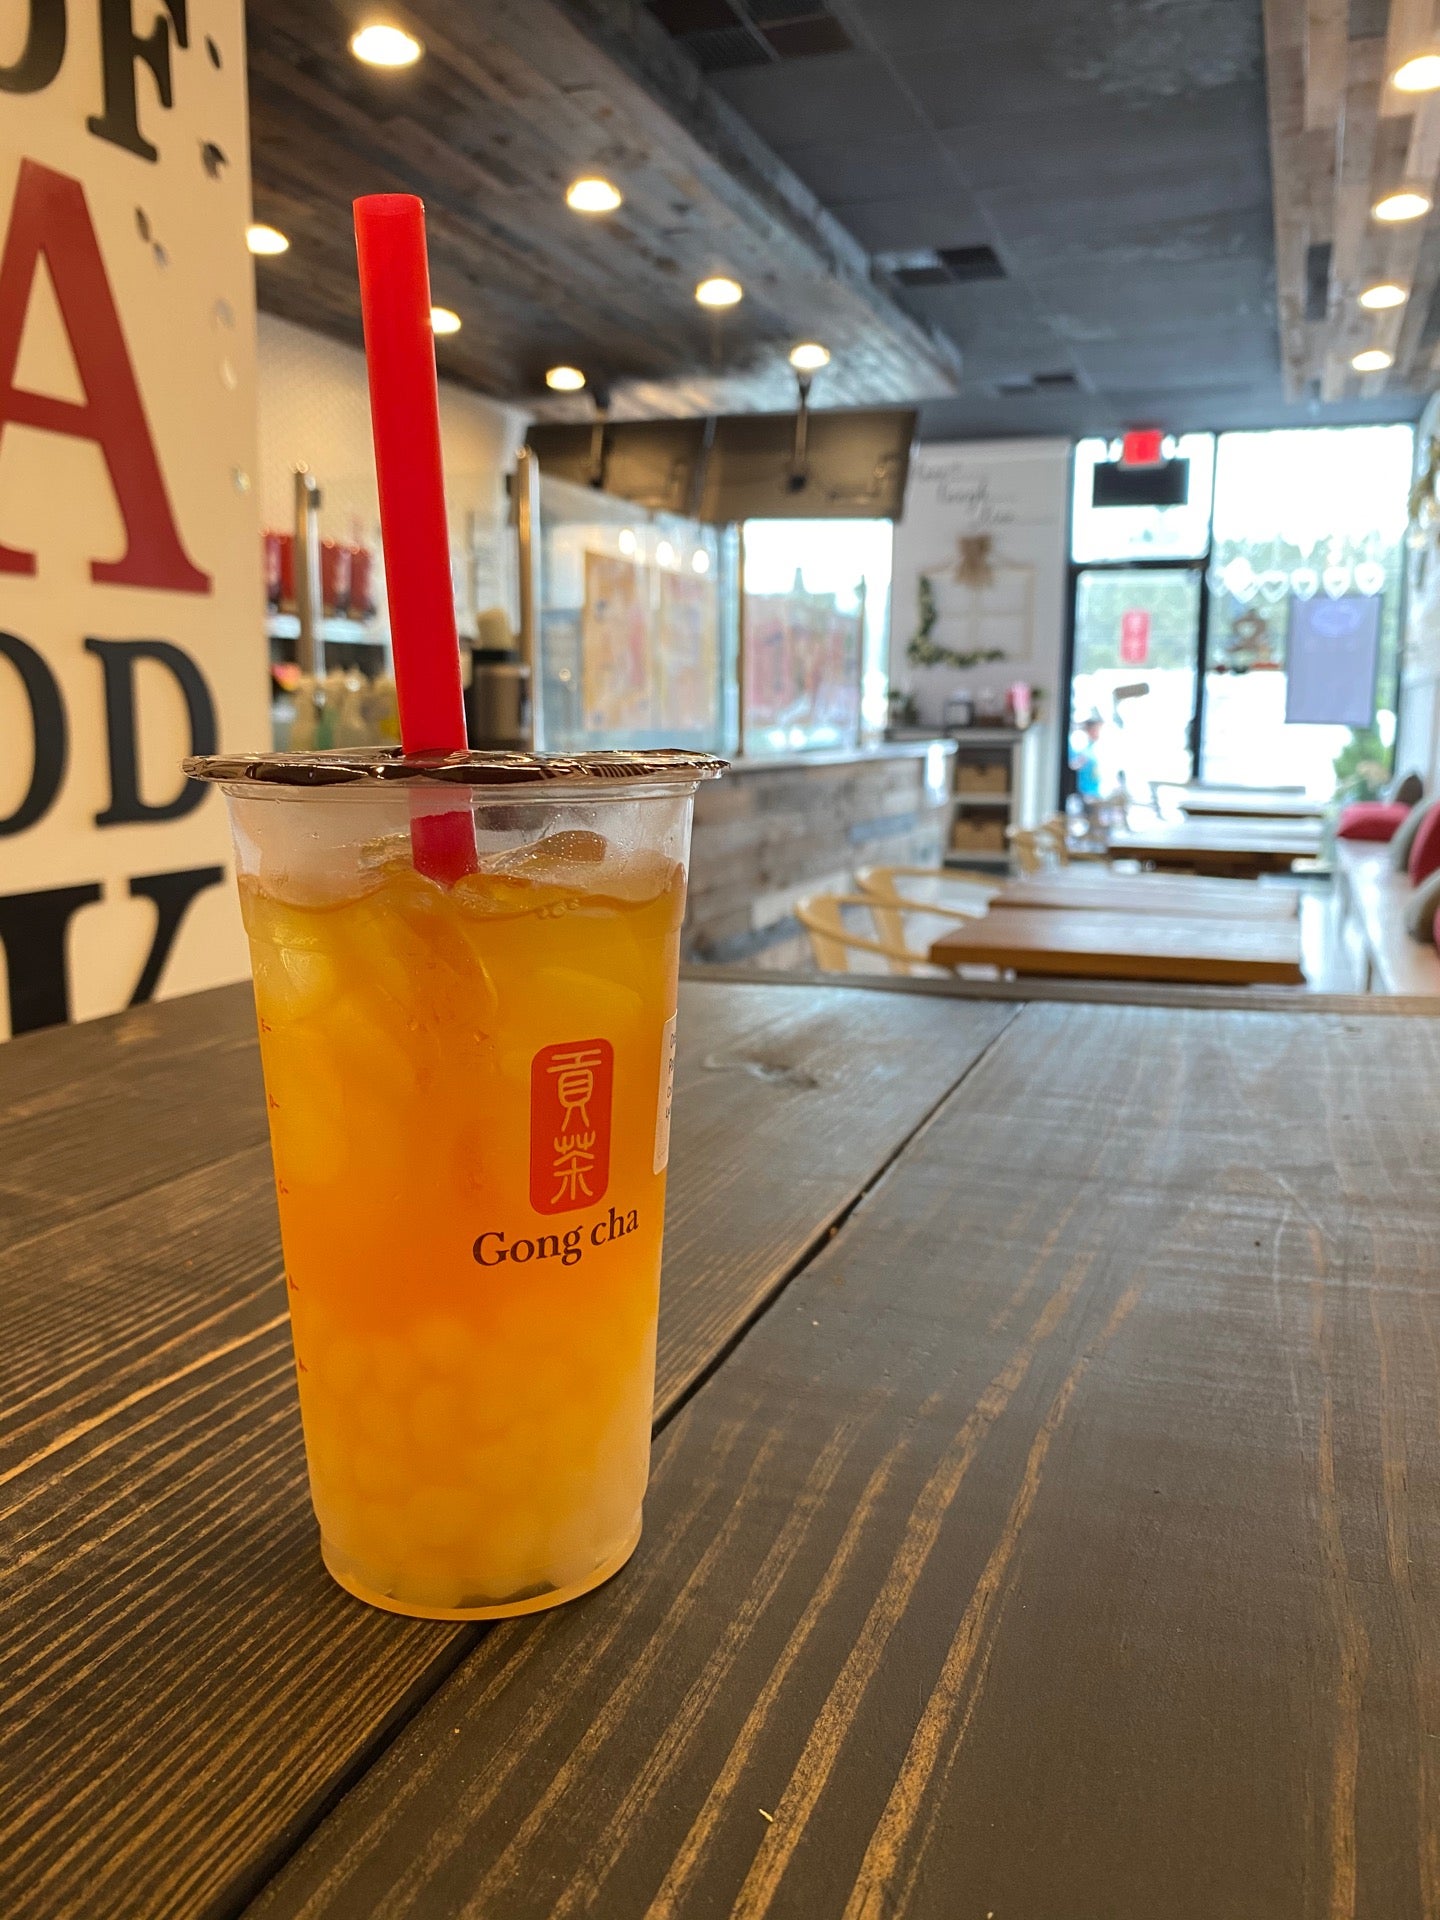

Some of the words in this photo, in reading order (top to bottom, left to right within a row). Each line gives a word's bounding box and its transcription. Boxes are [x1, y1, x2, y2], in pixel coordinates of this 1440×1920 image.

[0, 0, 188, 165] F
[546, 1048, 602, 1204] 貢茶
[472, 1225, 583, 1267] Gong
[590, 1206, 639, 1247] cha
